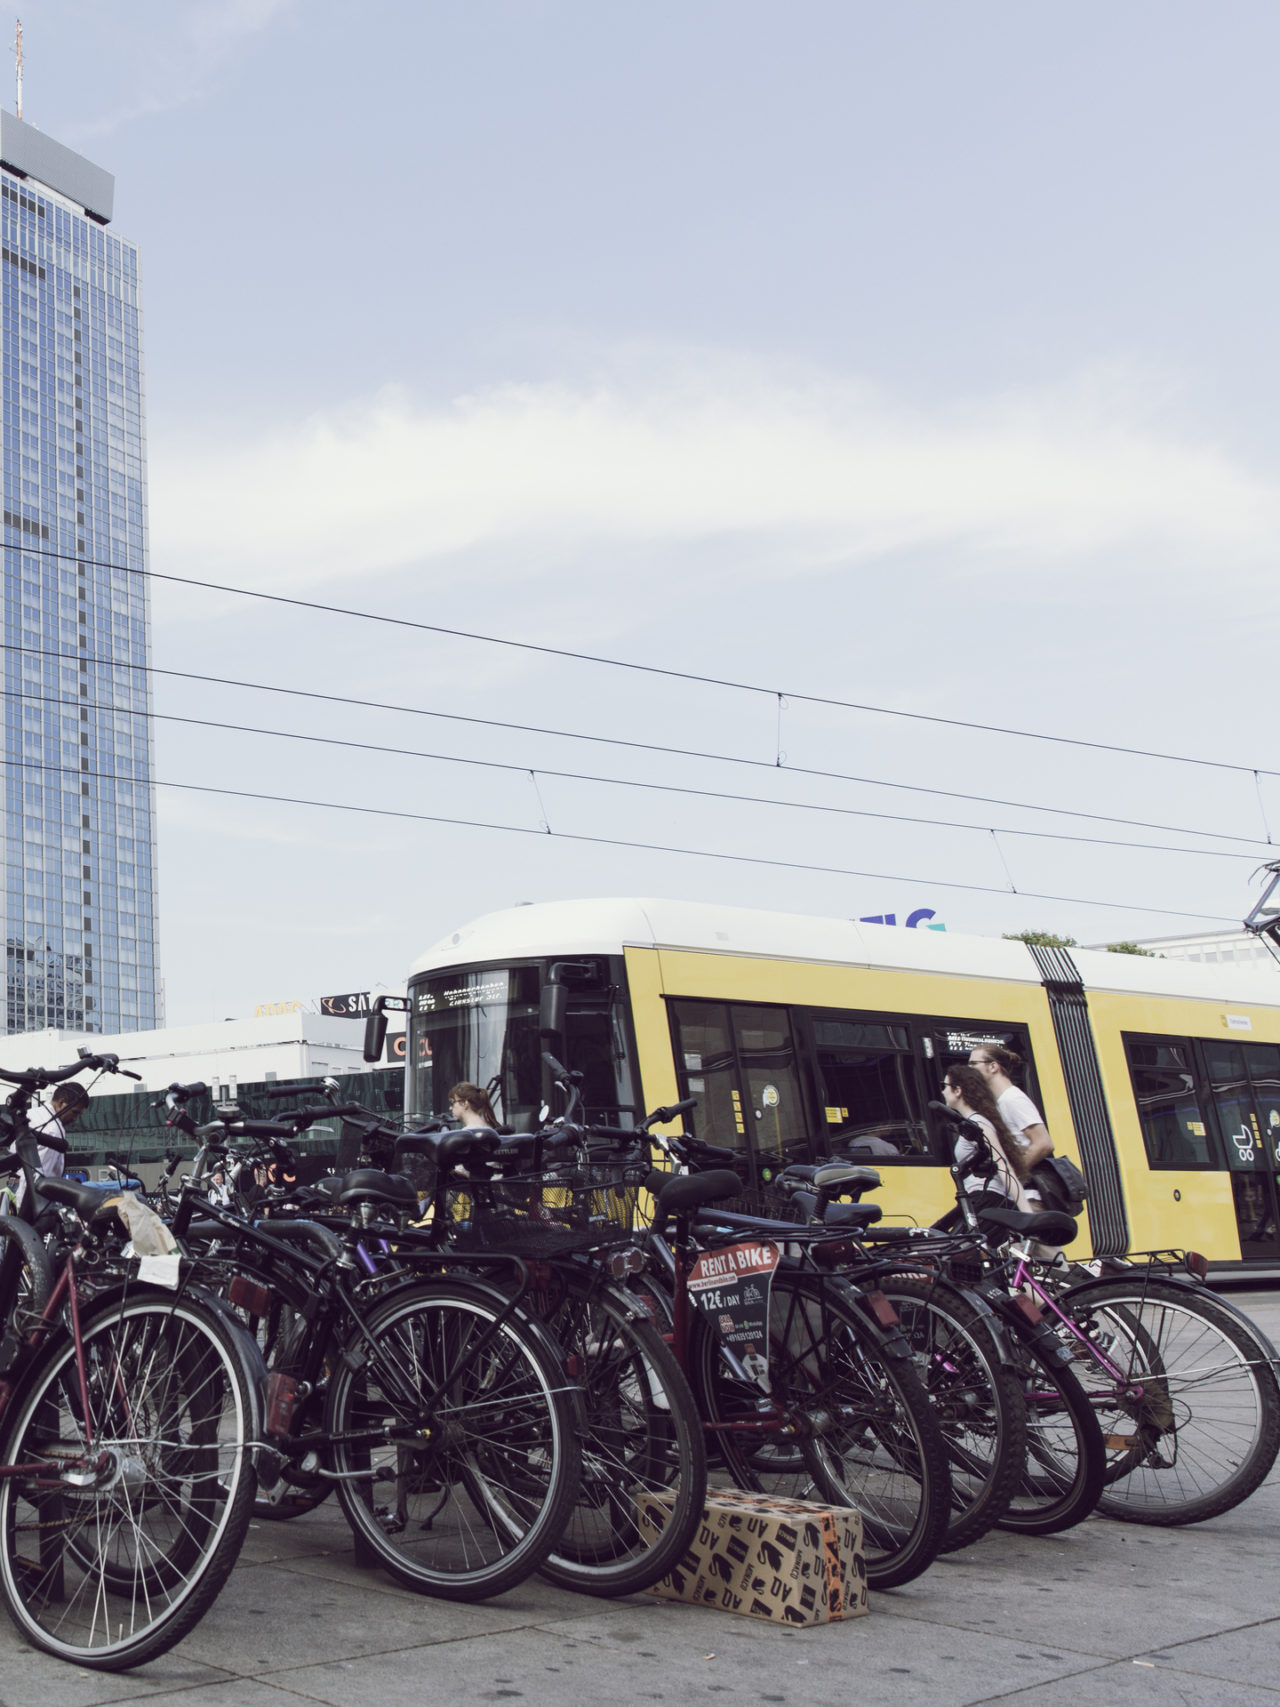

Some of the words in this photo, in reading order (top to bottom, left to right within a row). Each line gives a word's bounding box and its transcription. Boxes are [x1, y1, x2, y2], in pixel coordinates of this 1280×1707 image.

[700, 1255, 727, 1278] RENT
[728, 1253, 738, 1271] A
[736, 1246, 773, 1269] BIKE
[727, 1294, 740, 1307] DAY
[740, 1563, 755, 1591] MONACO
[790, 1549, 803, 1580] MONACO
